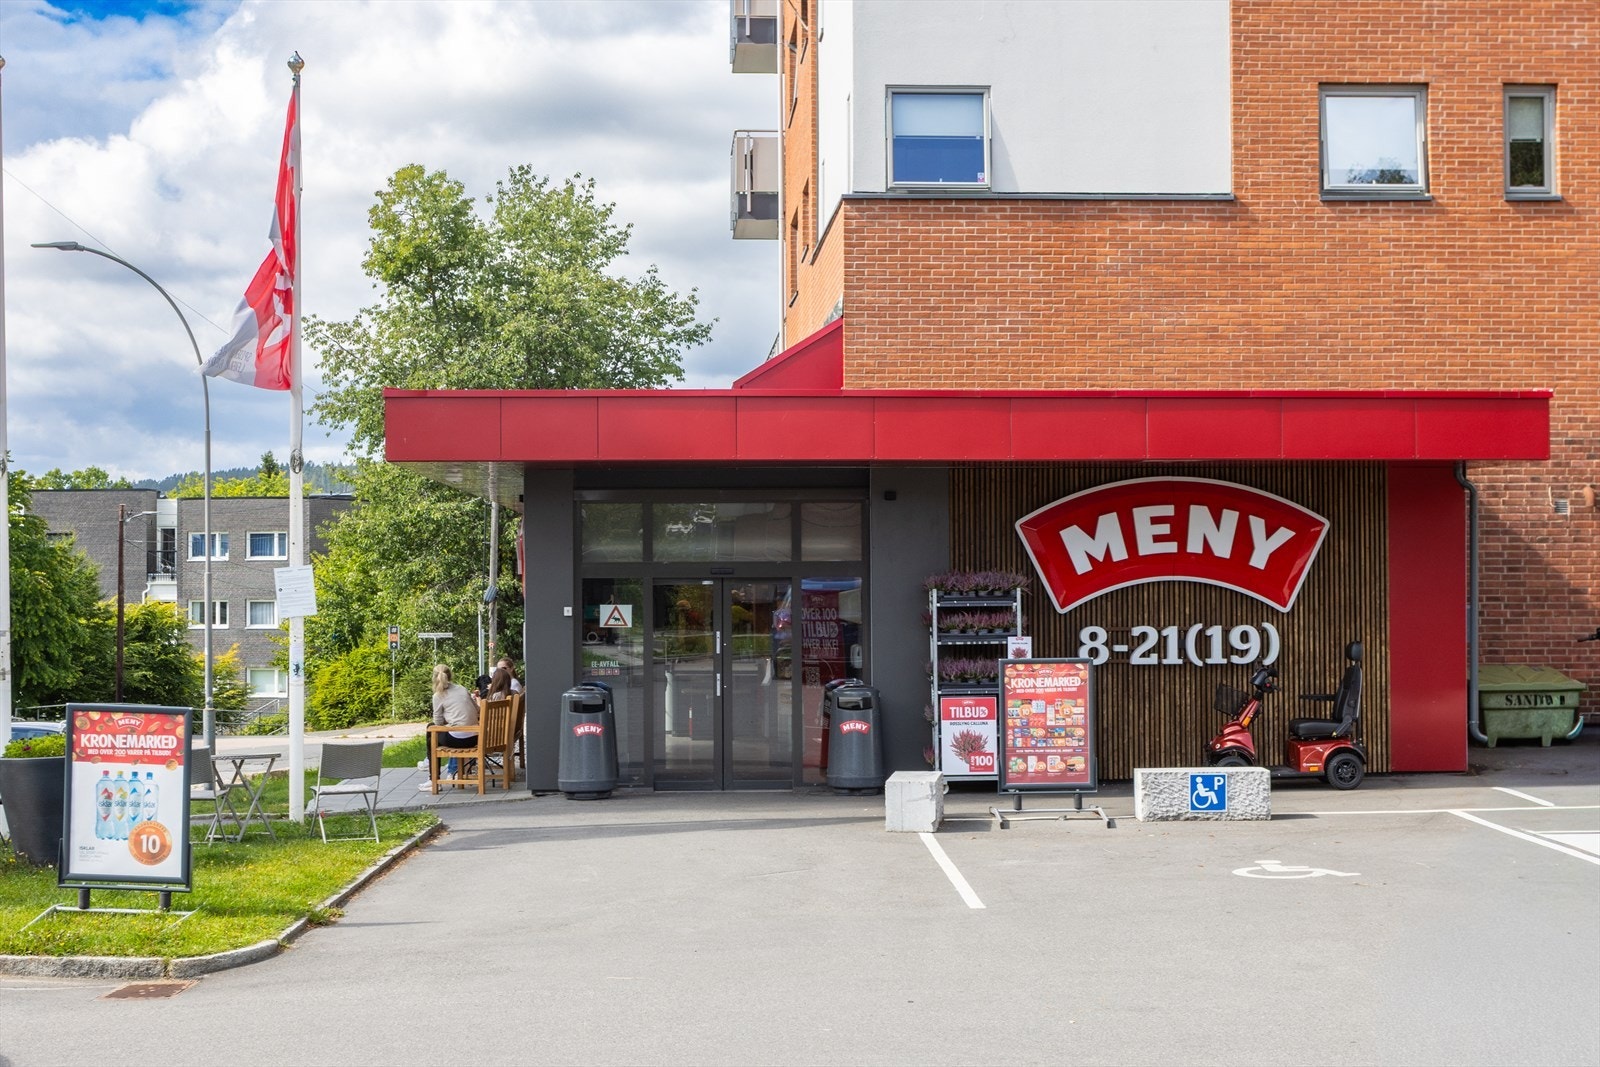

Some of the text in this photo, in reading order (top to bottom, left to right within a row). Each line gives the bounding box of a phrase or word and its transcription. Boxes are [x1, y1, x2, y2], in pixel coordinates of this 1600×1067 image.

[1059, 504, 1296, 575] MENY
[823, 608, 837, 620] 100
[1078, 622, 1280, 667] 8-21(19)
[1010, 676, 1082, 688] KRONEMARKED
[949, 706, 989, 718] TILBUD
[117, 718, 141, 726] MENY
[842, 722, 868, 731] MENY
[576, 725, 602, 734] MENY
[81, 733, 177, 749] KRONEMARKED
[975, 756, 993, 766] 100
[1214, 776, 1224, 790] P
[140, 834, 160, 853] 10
